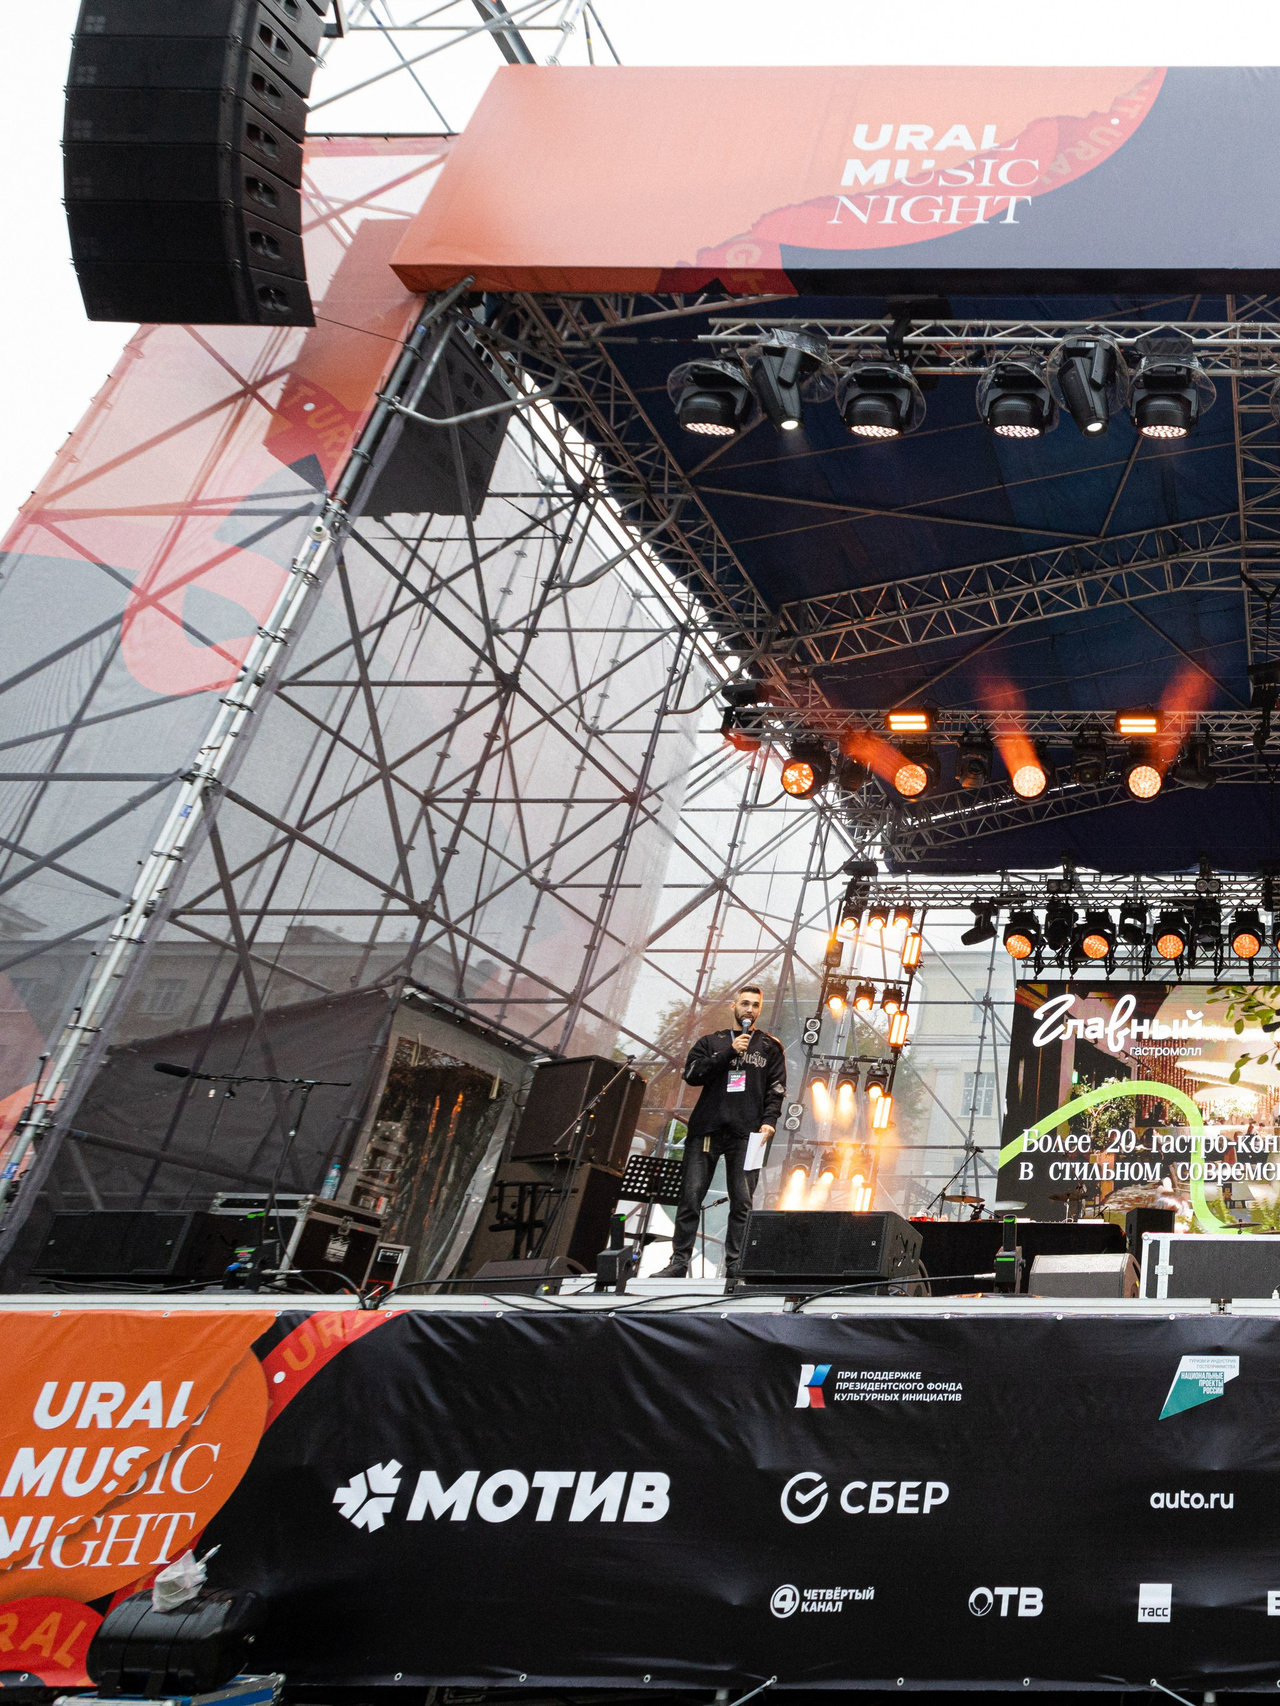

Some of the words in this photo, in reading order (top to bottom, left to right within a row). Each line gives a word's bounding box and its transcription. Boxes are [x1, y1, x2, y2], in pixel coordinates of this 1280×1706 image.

[852, 123, 1018, 151] URAL
[840, 158, 1040, 187] MUSIC
[828, 195, 1032, 224] NIGHT
[1032, 993, 1205, 1052] Главный
[1129, 1046, 1202, 1058] гастромолл
[1021, 1129, 1091, 1154] Более
[1106, 1129, 1137, 1154] 20
[1019, 1162, 1034, 1181] в
[1049, 1162, 1162, 1181] стильном
[836, 1382, 924, 1391] ПРЕЗИДЕНТСКОГО
[926, 1382, 963, 1391] ФОНДА
[838, 1371, 858, 1380] ПРИ
[860, 1371, 922, 1380] ПОДДЕРЖКЕ
[1180, 1372, 1224, 1380] НАЦИОНАЛЬНЫЕ
[32, 1380, 210, 1430] URAL
[834, 1393, 900, 1401] КУЛЬТУРНЫХ
[902, 1393, 962, 1402] ИНИЦИАТИВ
[2, 1442, 221, 1498] MUSIC
[406, 1470, 671, 1523] МОТИВ
[839, 1480, 950, 1514] СБЕР
[1149, 1489, 1234, 1510] auto.ru
[803, 1586, 875, 1600] ЧЕТВЁРТЫЙ
[800, 1600, 843, 1613] КАНАЛ
